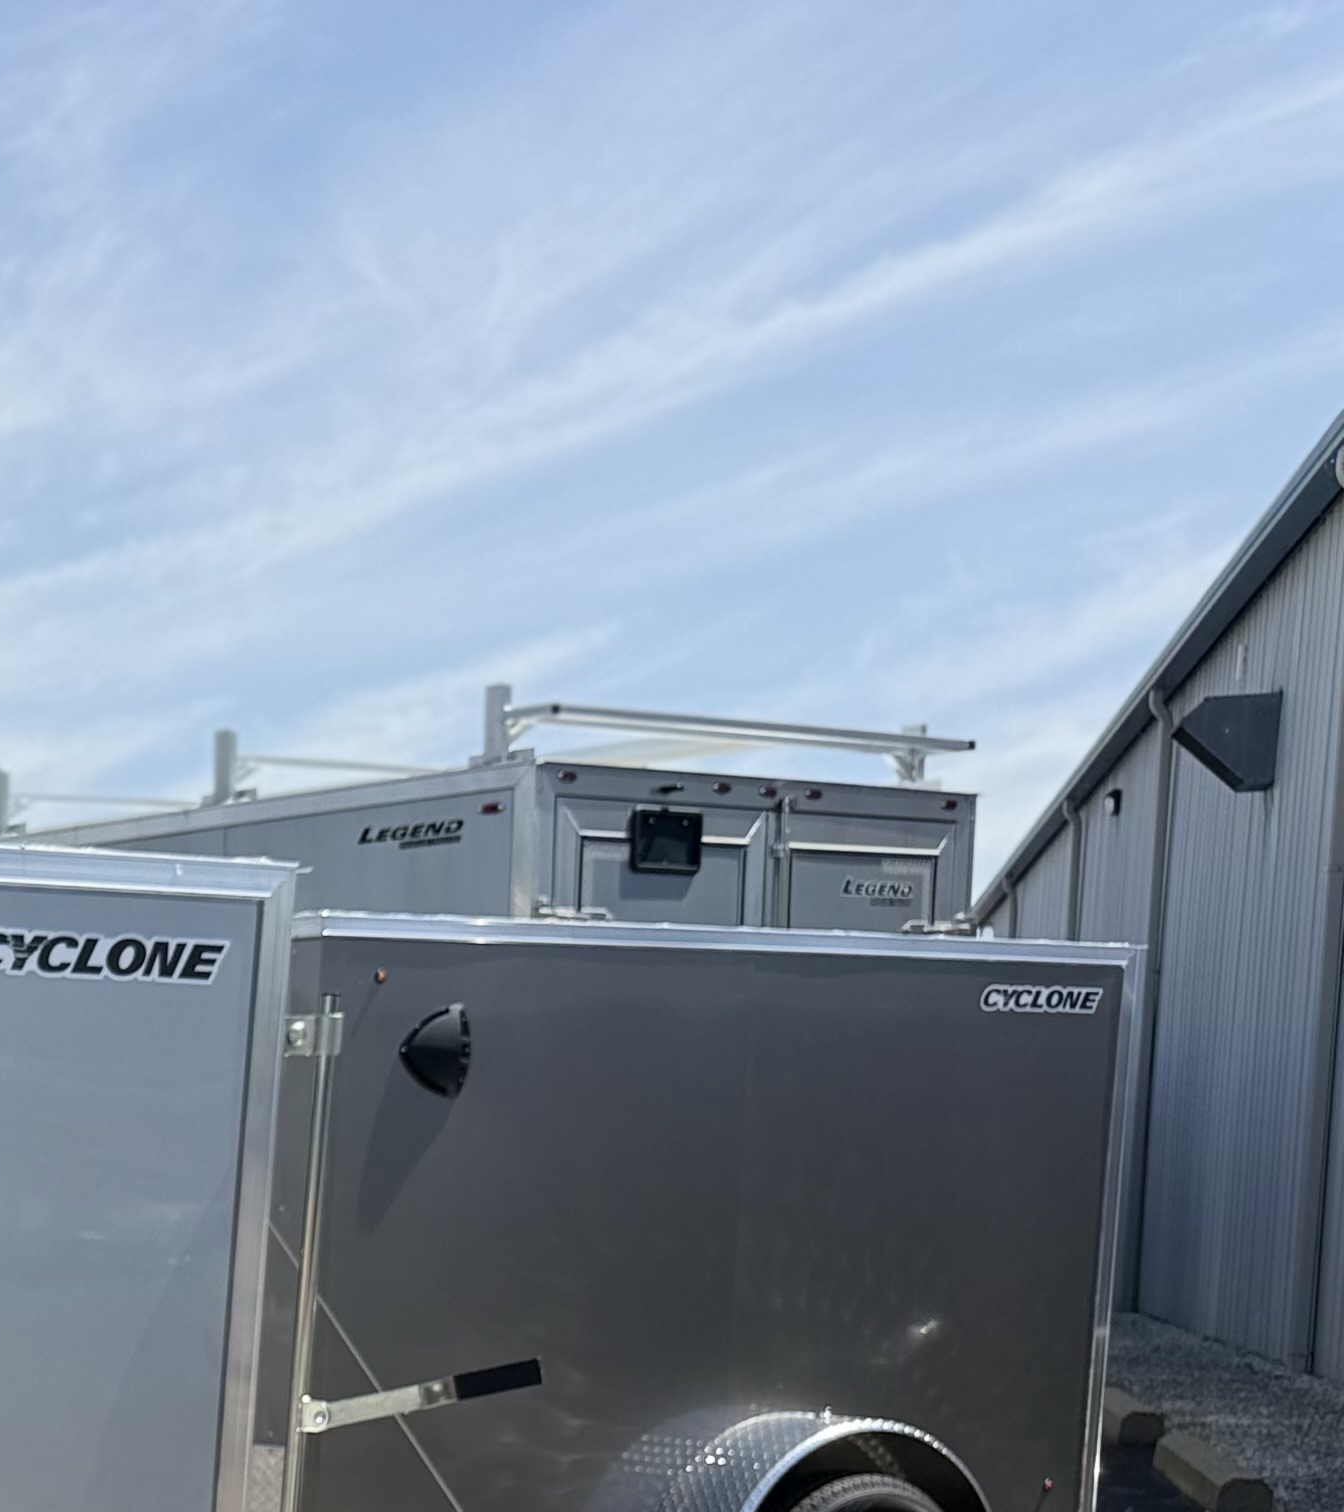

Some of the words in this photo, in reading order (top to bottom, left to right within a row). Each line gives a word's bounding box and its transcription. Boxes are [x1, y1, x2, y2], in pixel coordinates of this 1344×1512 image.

[357, 819, 464, 845] LEGEND
[842, 879, 913, 898] LEGEND
[982, 987, 1100, 1011] CYCLONE
